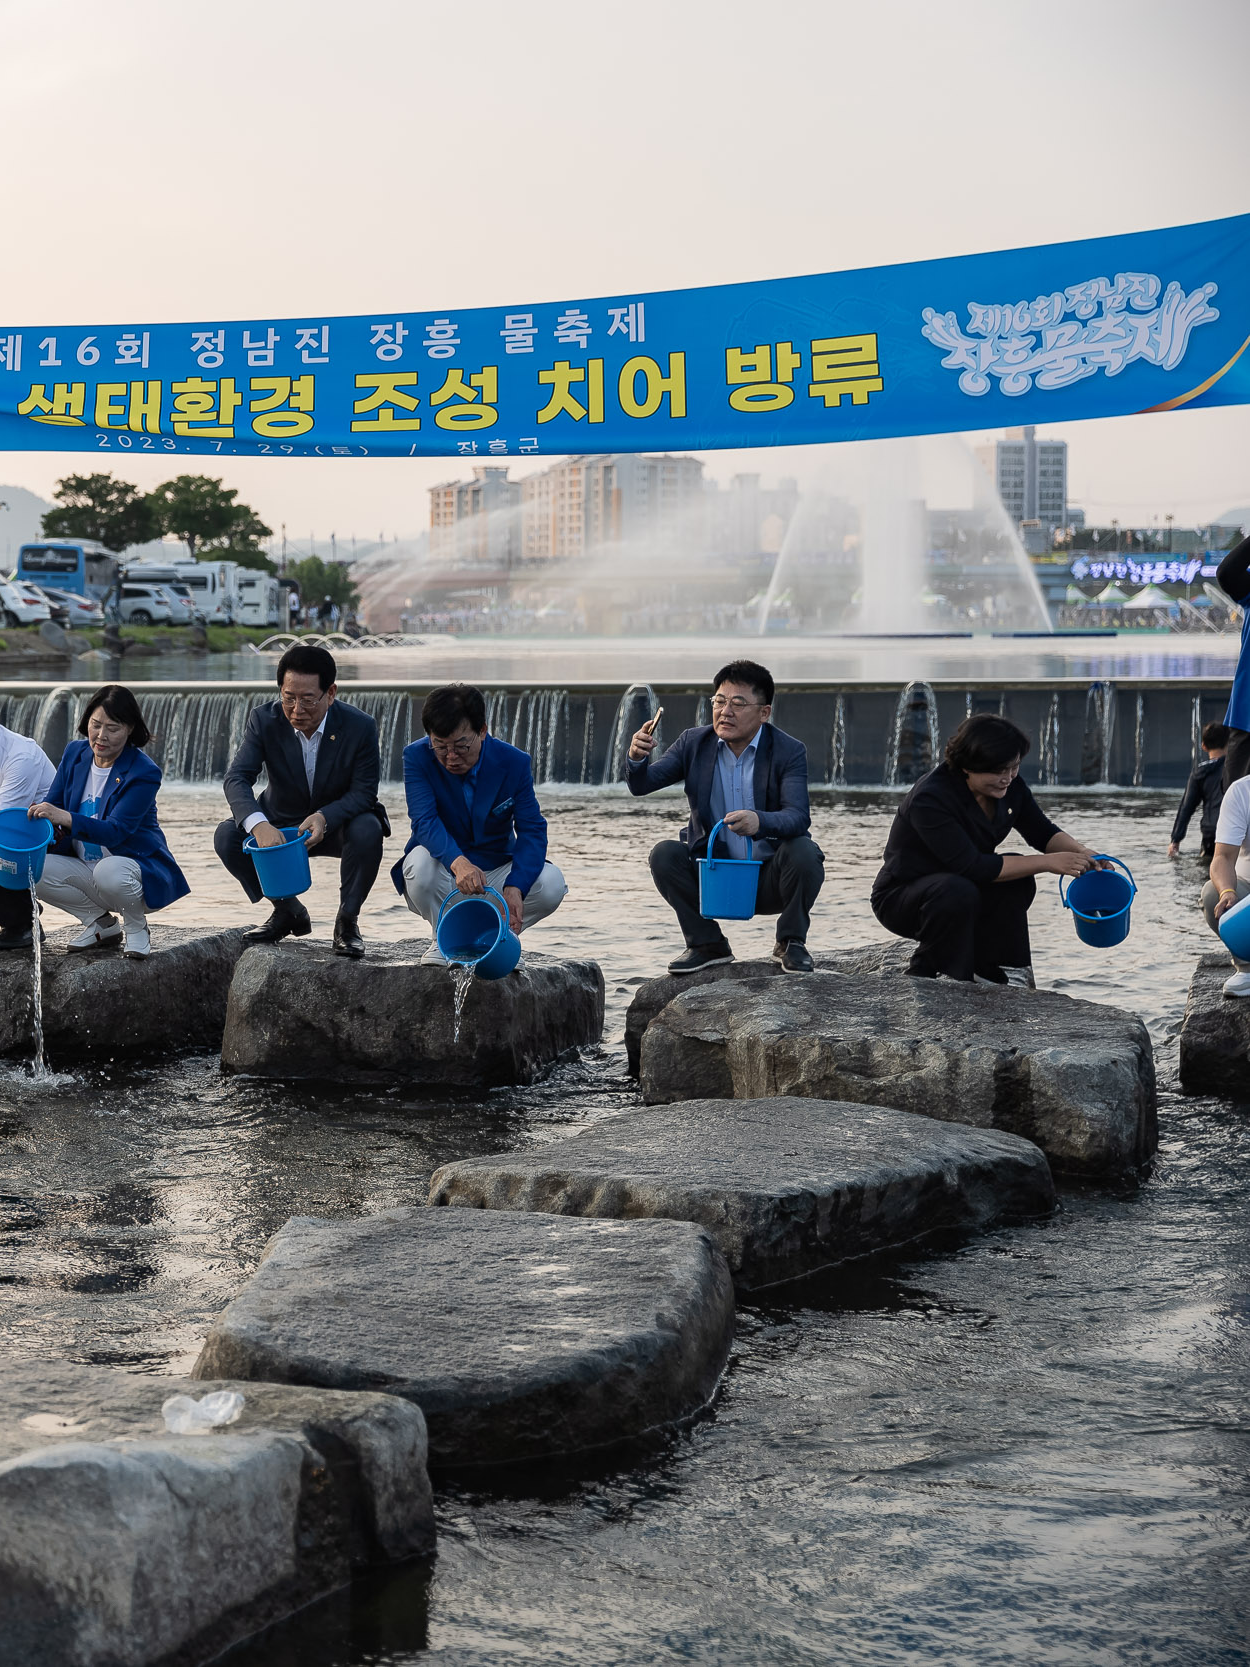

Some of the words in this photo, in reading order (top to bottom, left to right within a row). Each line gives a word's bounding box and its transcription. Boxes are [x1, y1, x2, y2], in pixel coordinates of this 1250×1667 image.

[190, 325, 330, 368] 정남진
[369, 318, 461, 362] 장흥
[499, 302, 646, 355] 물축제
[971, 295, 1063, 333] 제16회
[1067, 276, 1157, 316] 정남진
[16, 373, 316, 438] 생태환경
[350, 364, 499, 433] 조성
[536, 350, 687, 425] 치어
[724, 332, 884, 414] 방류
[457, 436, 540, 455] 장흥군
